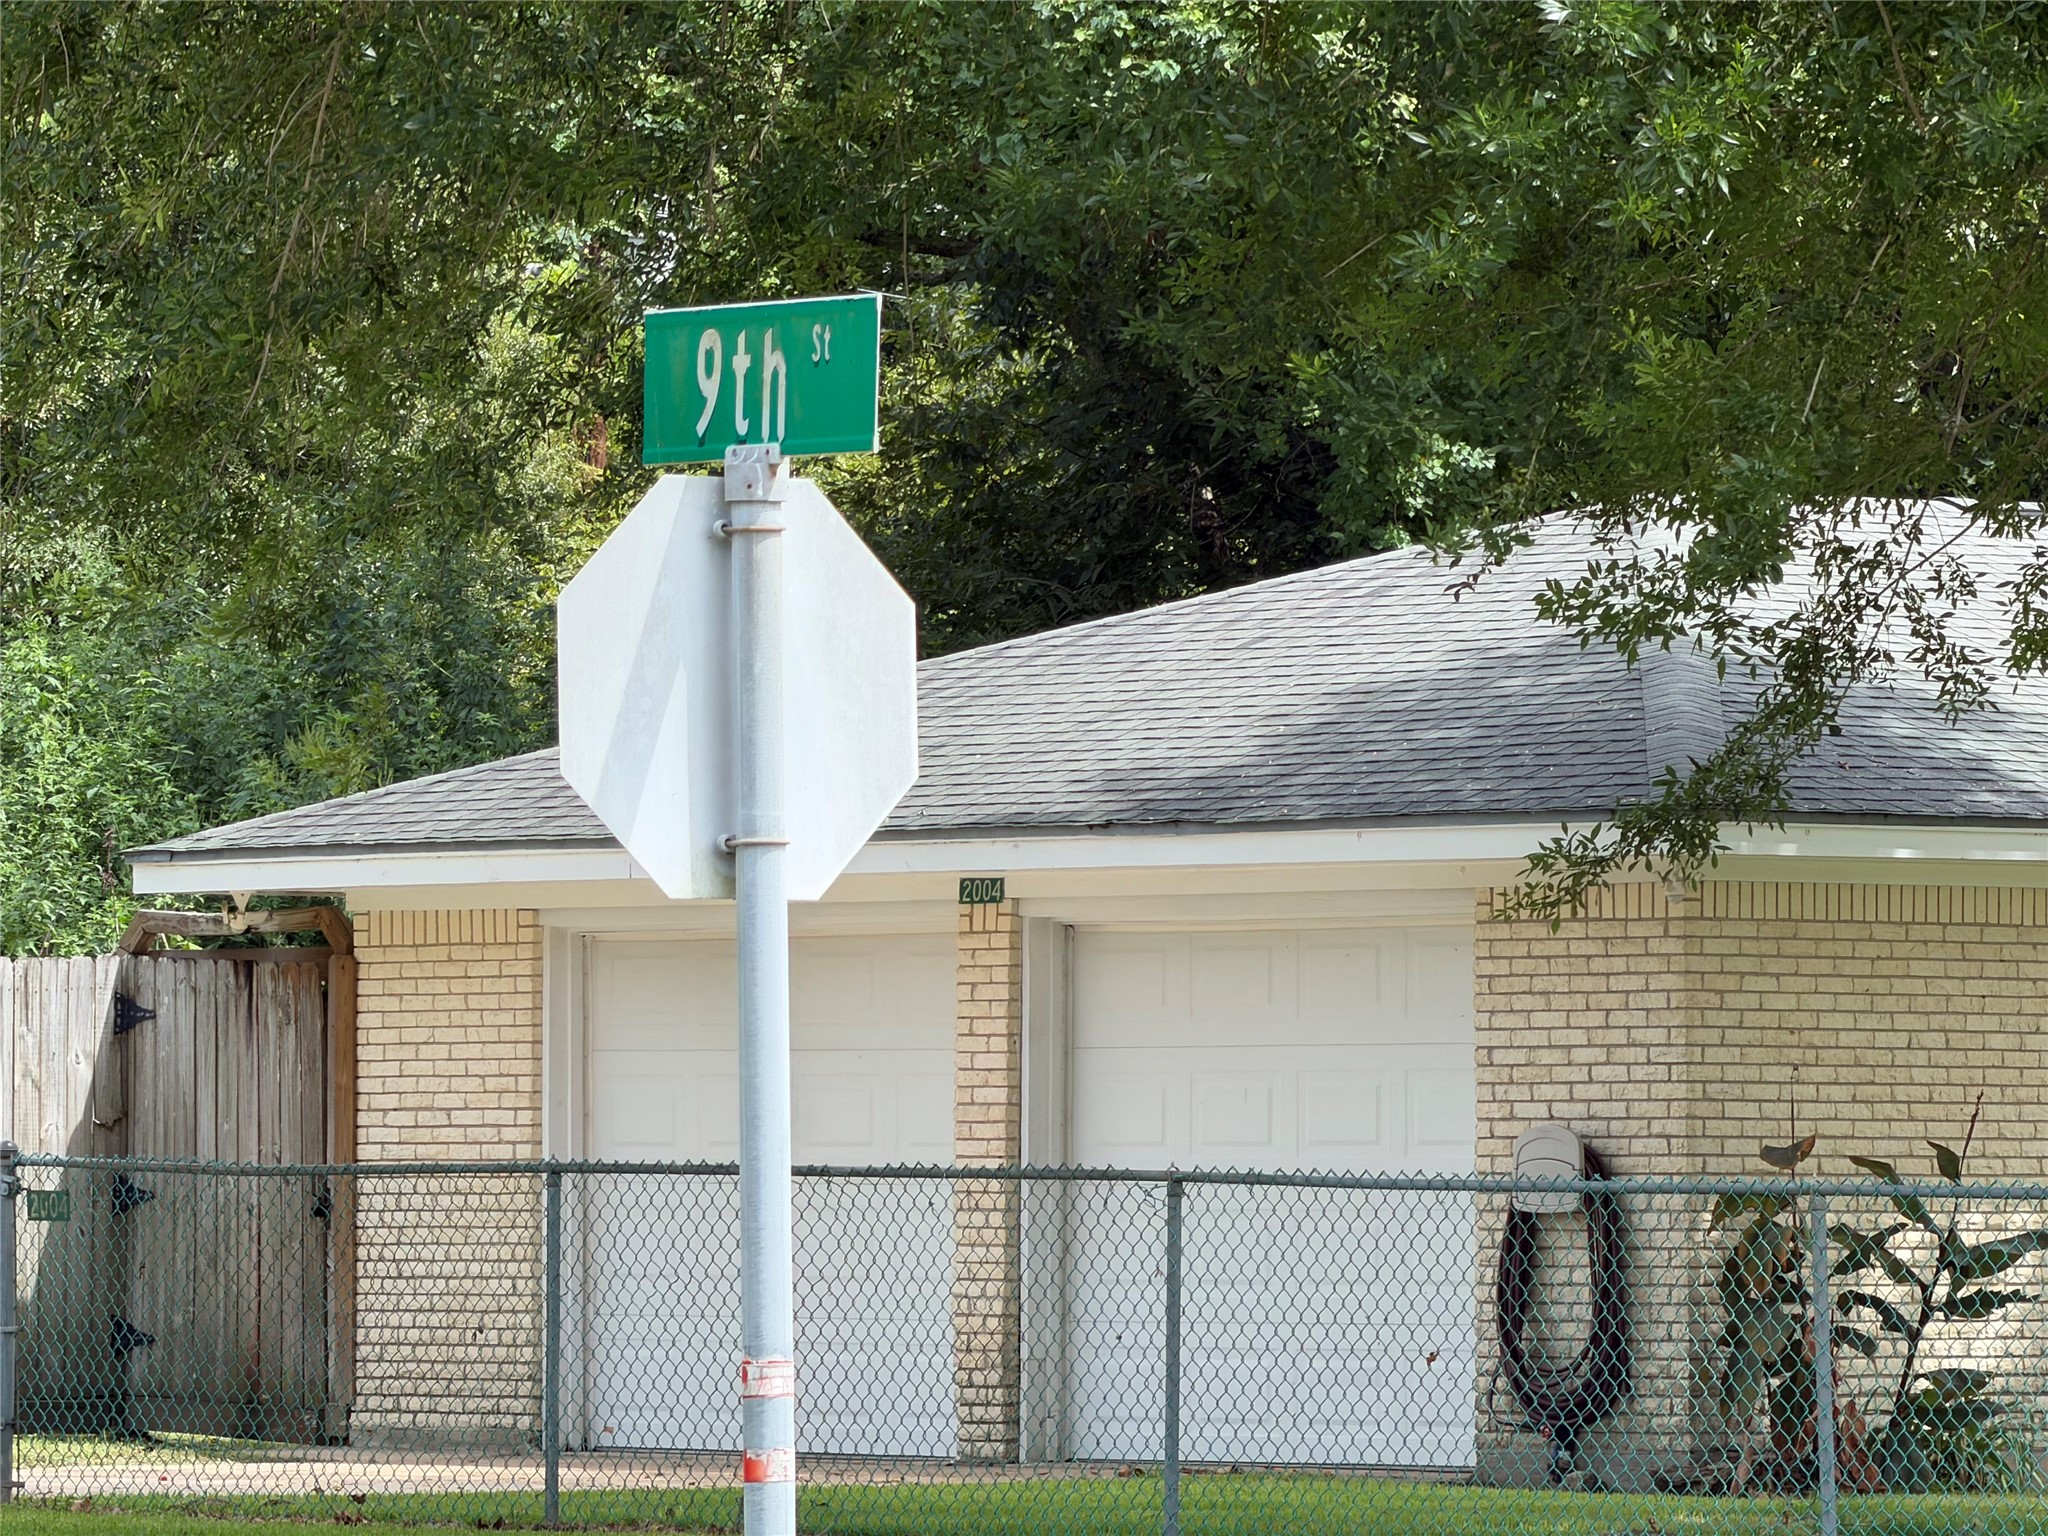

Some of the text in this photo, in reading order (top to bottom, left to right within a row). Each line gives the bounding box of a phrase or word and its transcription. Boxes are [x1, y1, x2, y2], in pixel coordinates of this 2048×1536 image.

[696, 324, 831, 444] 9th St
[962, 880, 1001, 902] 2004
[31, 1193, 67, 1218] 2004
